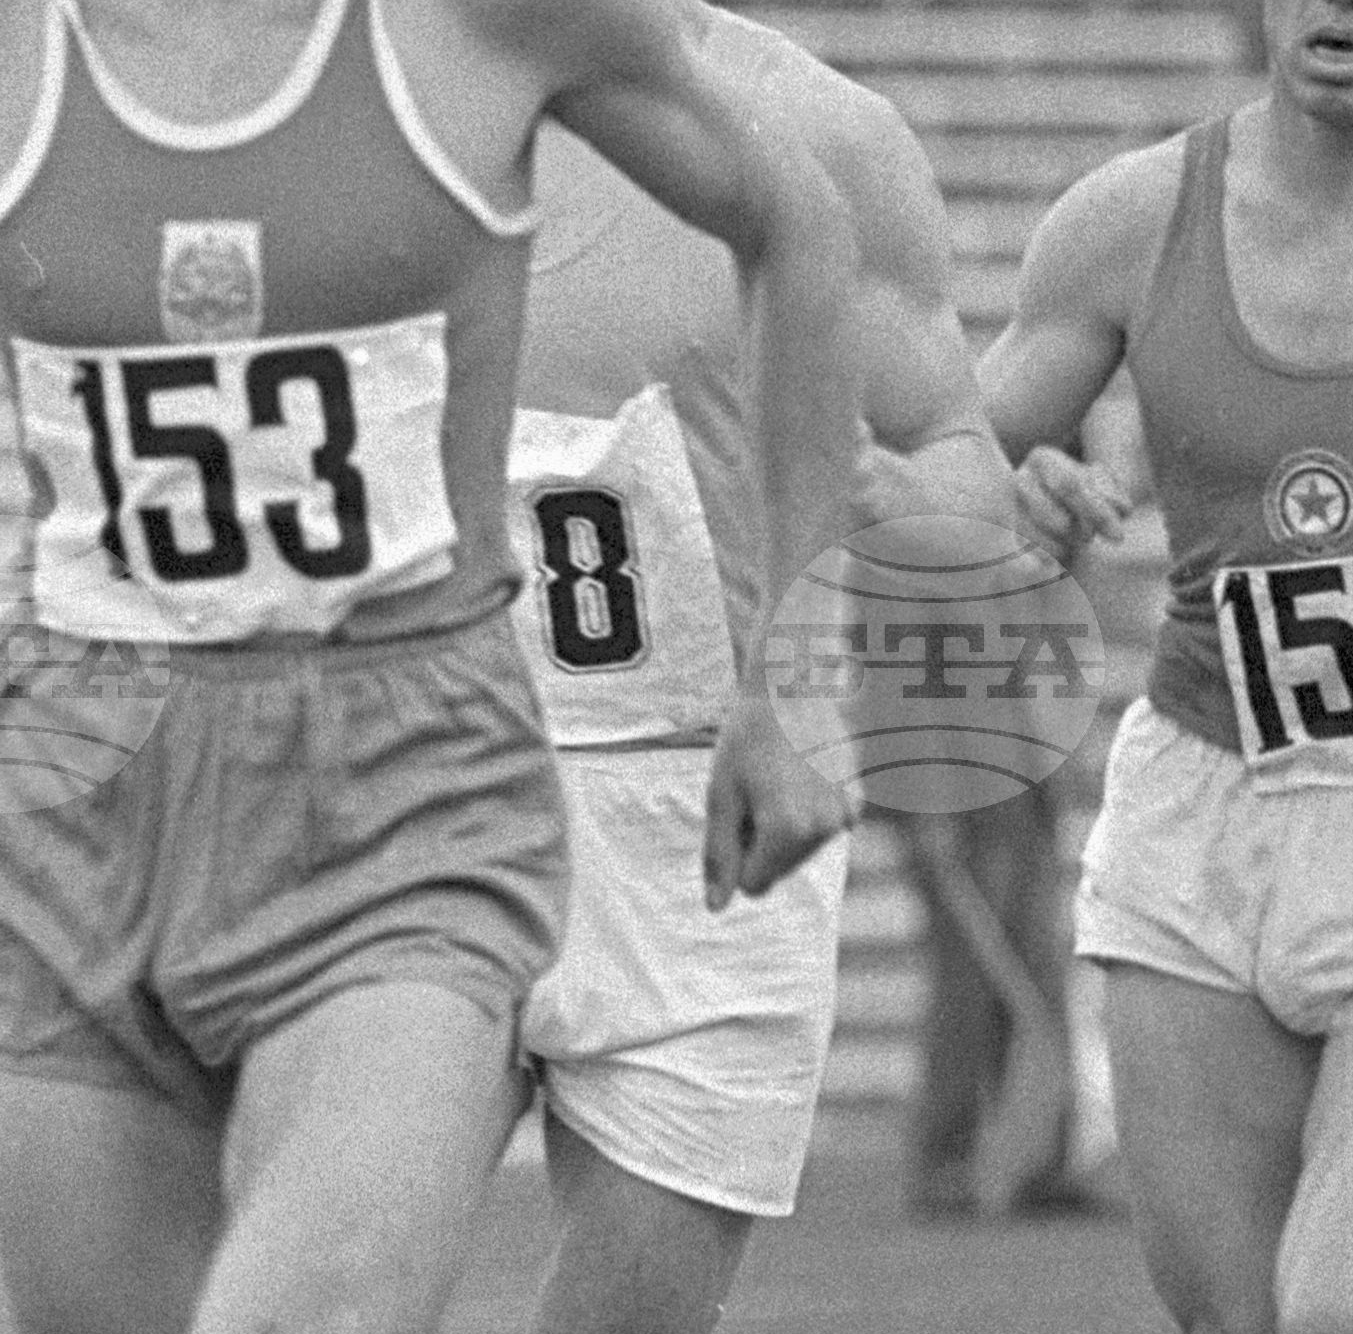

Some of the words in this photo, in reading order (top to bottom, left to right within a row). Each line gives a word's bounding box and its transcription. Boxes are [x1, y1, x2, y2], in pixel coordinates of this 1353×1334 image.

[71, 344, 372, 582] 153
[532, 486, 648, 671] 8
[1221, 564, 1353, 755] 15
